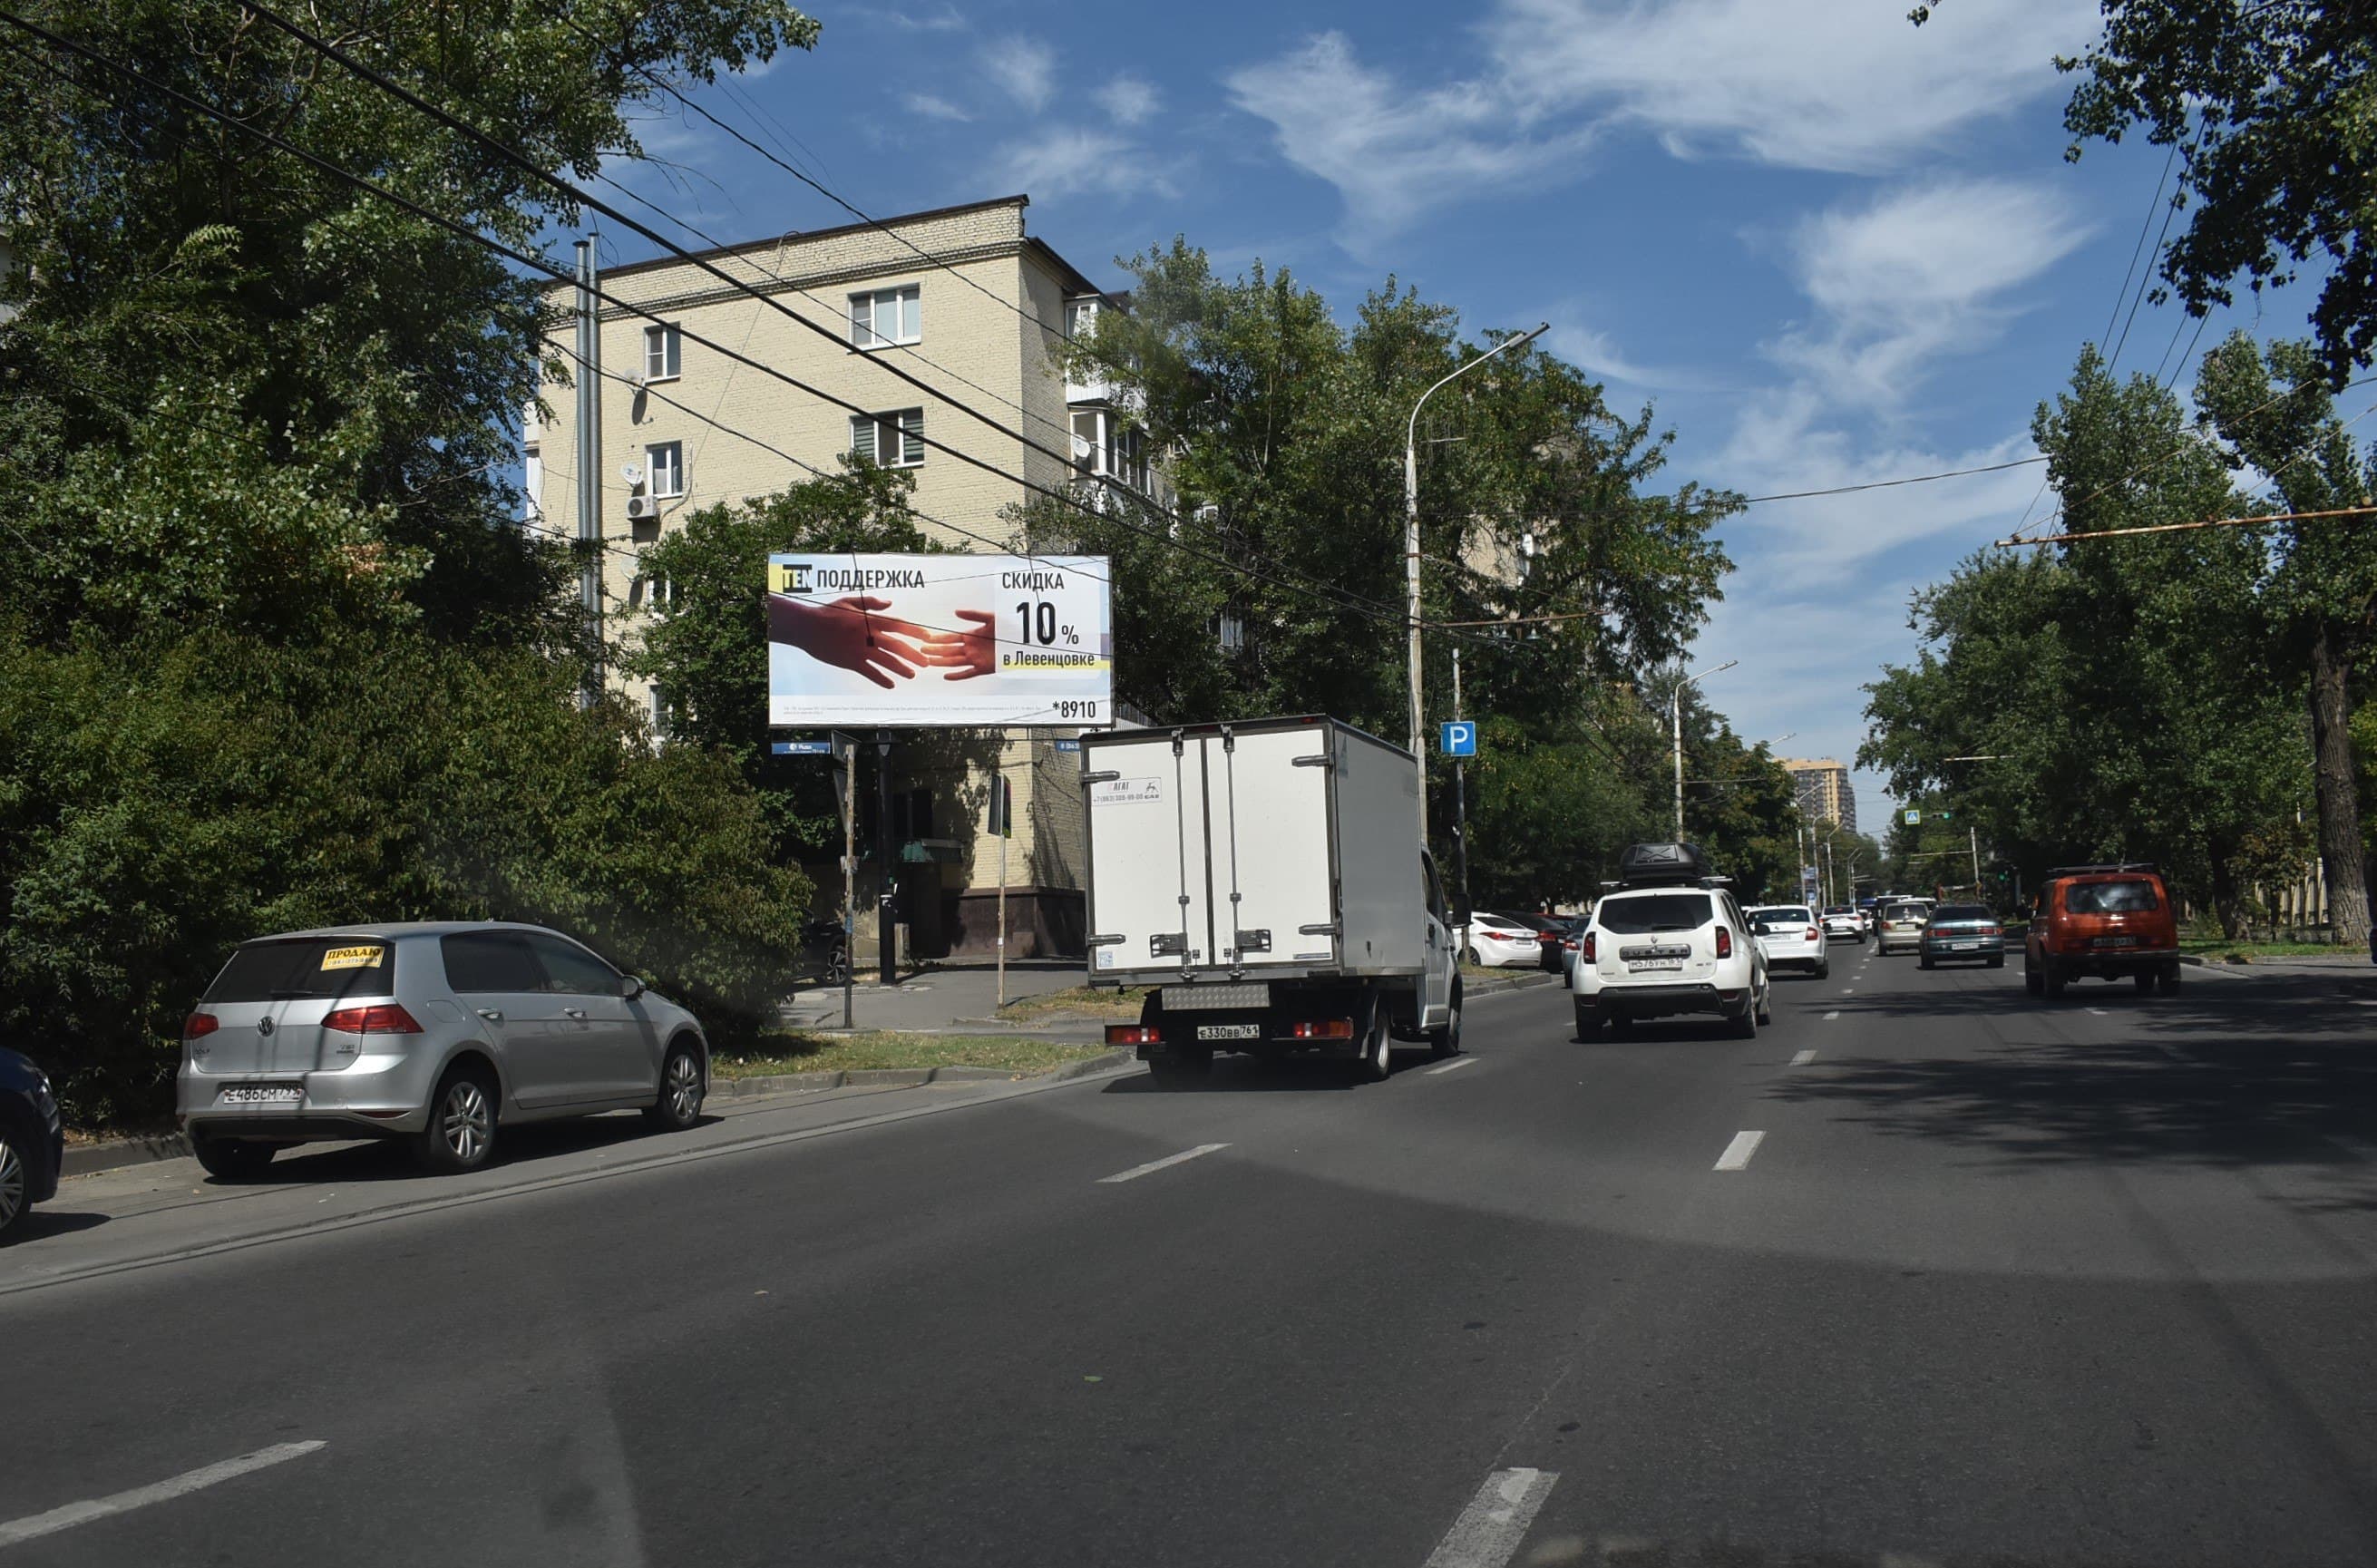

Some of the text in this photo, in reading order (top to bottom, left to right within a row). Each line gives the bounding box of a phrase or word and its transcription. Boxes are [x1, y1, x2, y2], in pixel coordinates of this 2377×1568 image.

[817, 570, 925, 590] ПОДДЕРЖКА
[1002, 572, 1065, 592] СКИДКА
[1003, 650, 1095, 668] в Левенцовке
[327, 948, 381, 959] ПРОДАЮ
